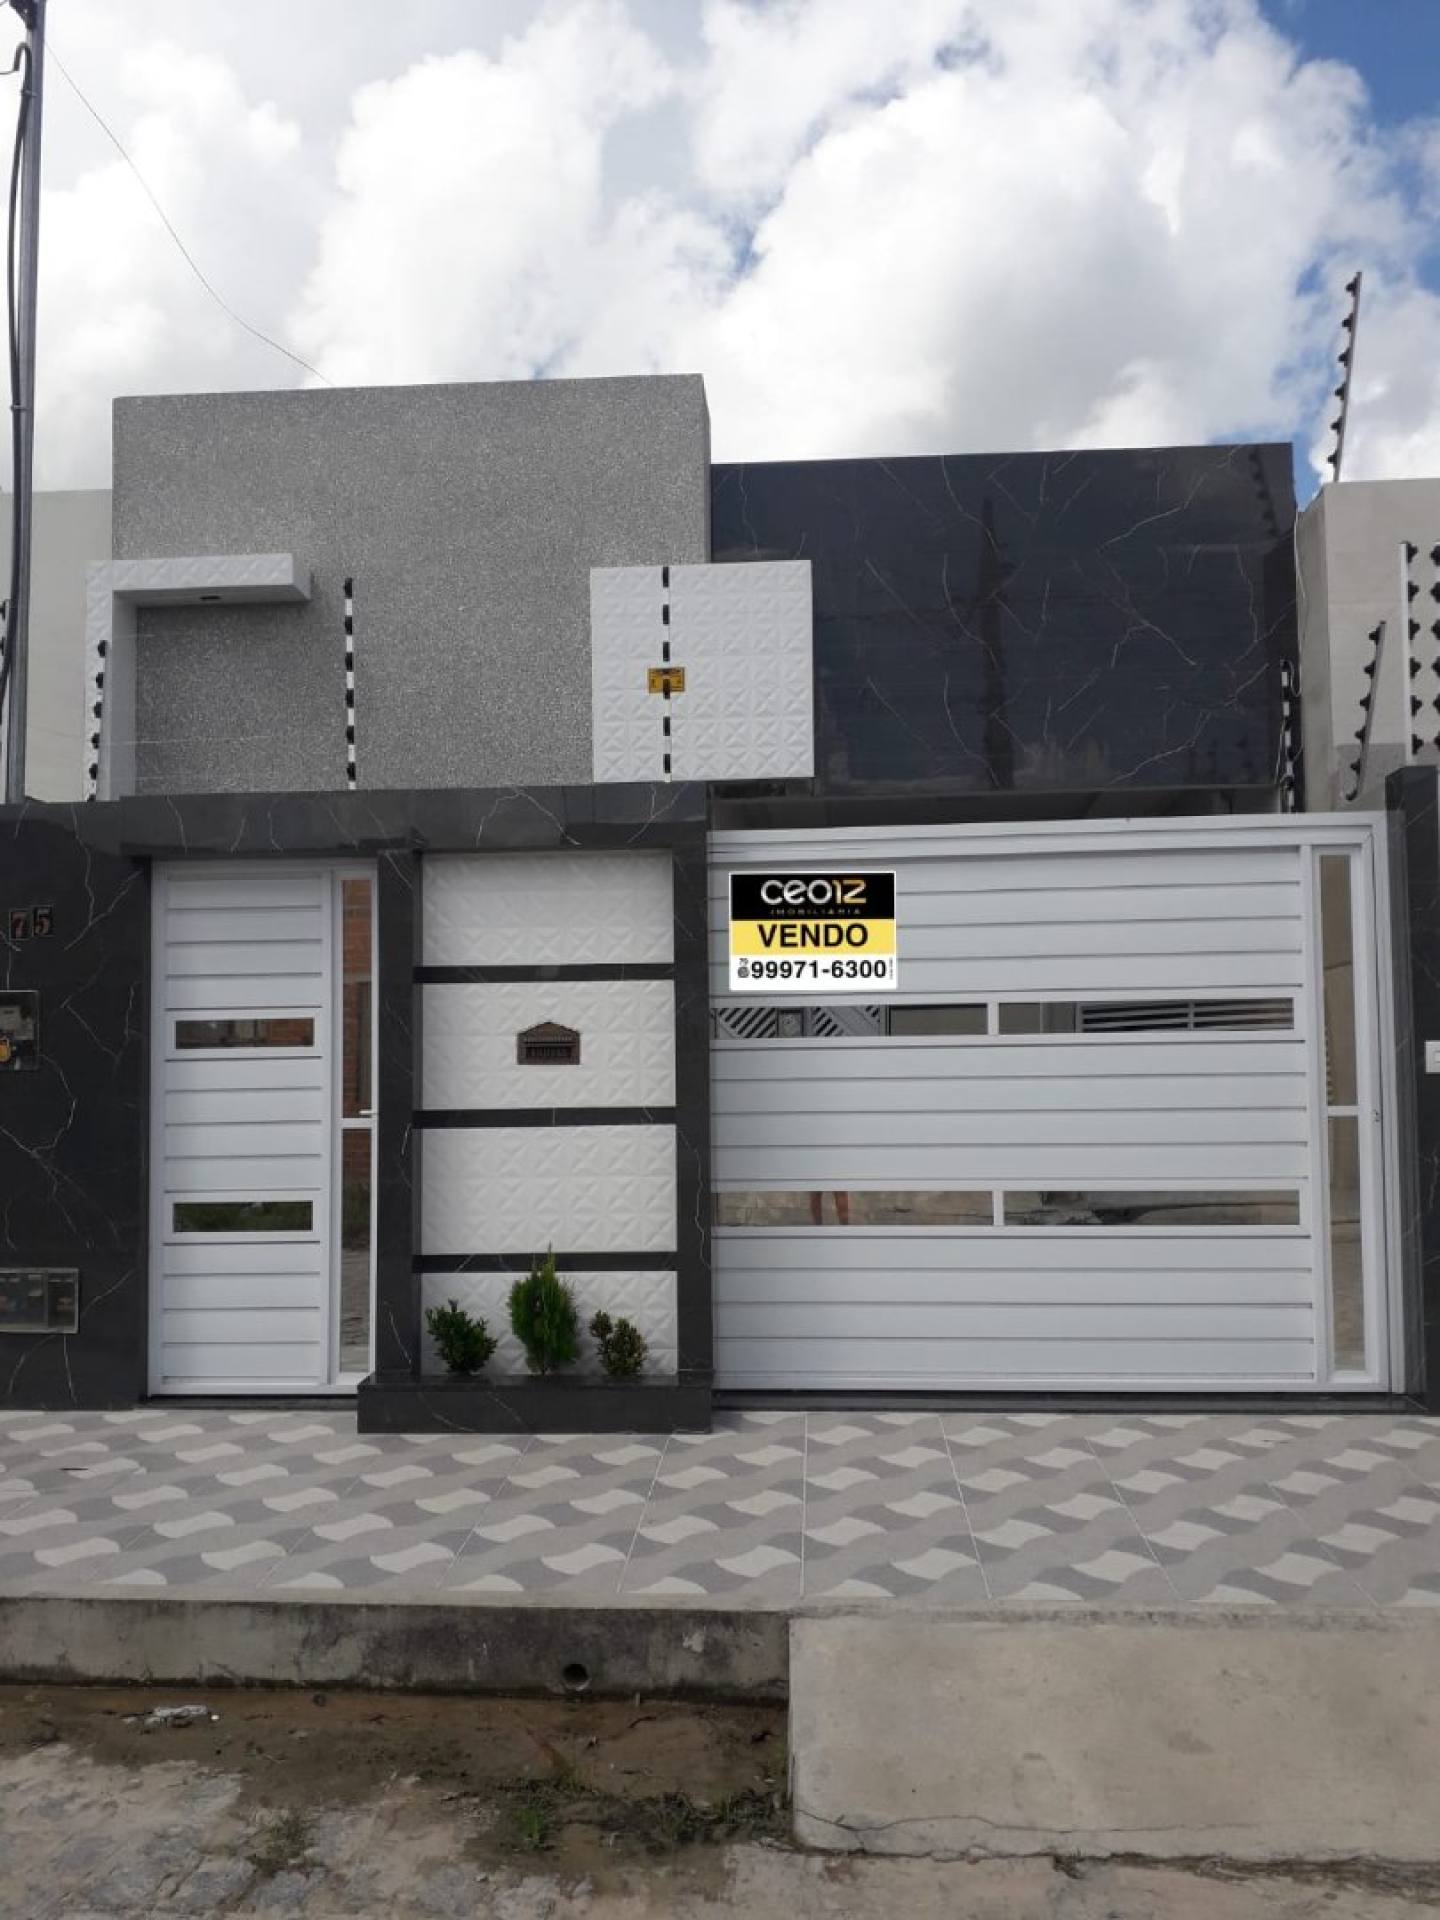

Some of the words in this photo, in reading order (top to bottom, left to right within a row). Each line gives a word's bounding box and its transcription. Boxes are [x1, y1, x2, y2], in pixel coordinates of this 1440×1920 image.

[12, 908, 50, 937] 75
[757, 924, 868, 948] VENDO
[751, 960, 886, 979] 99971-6300
